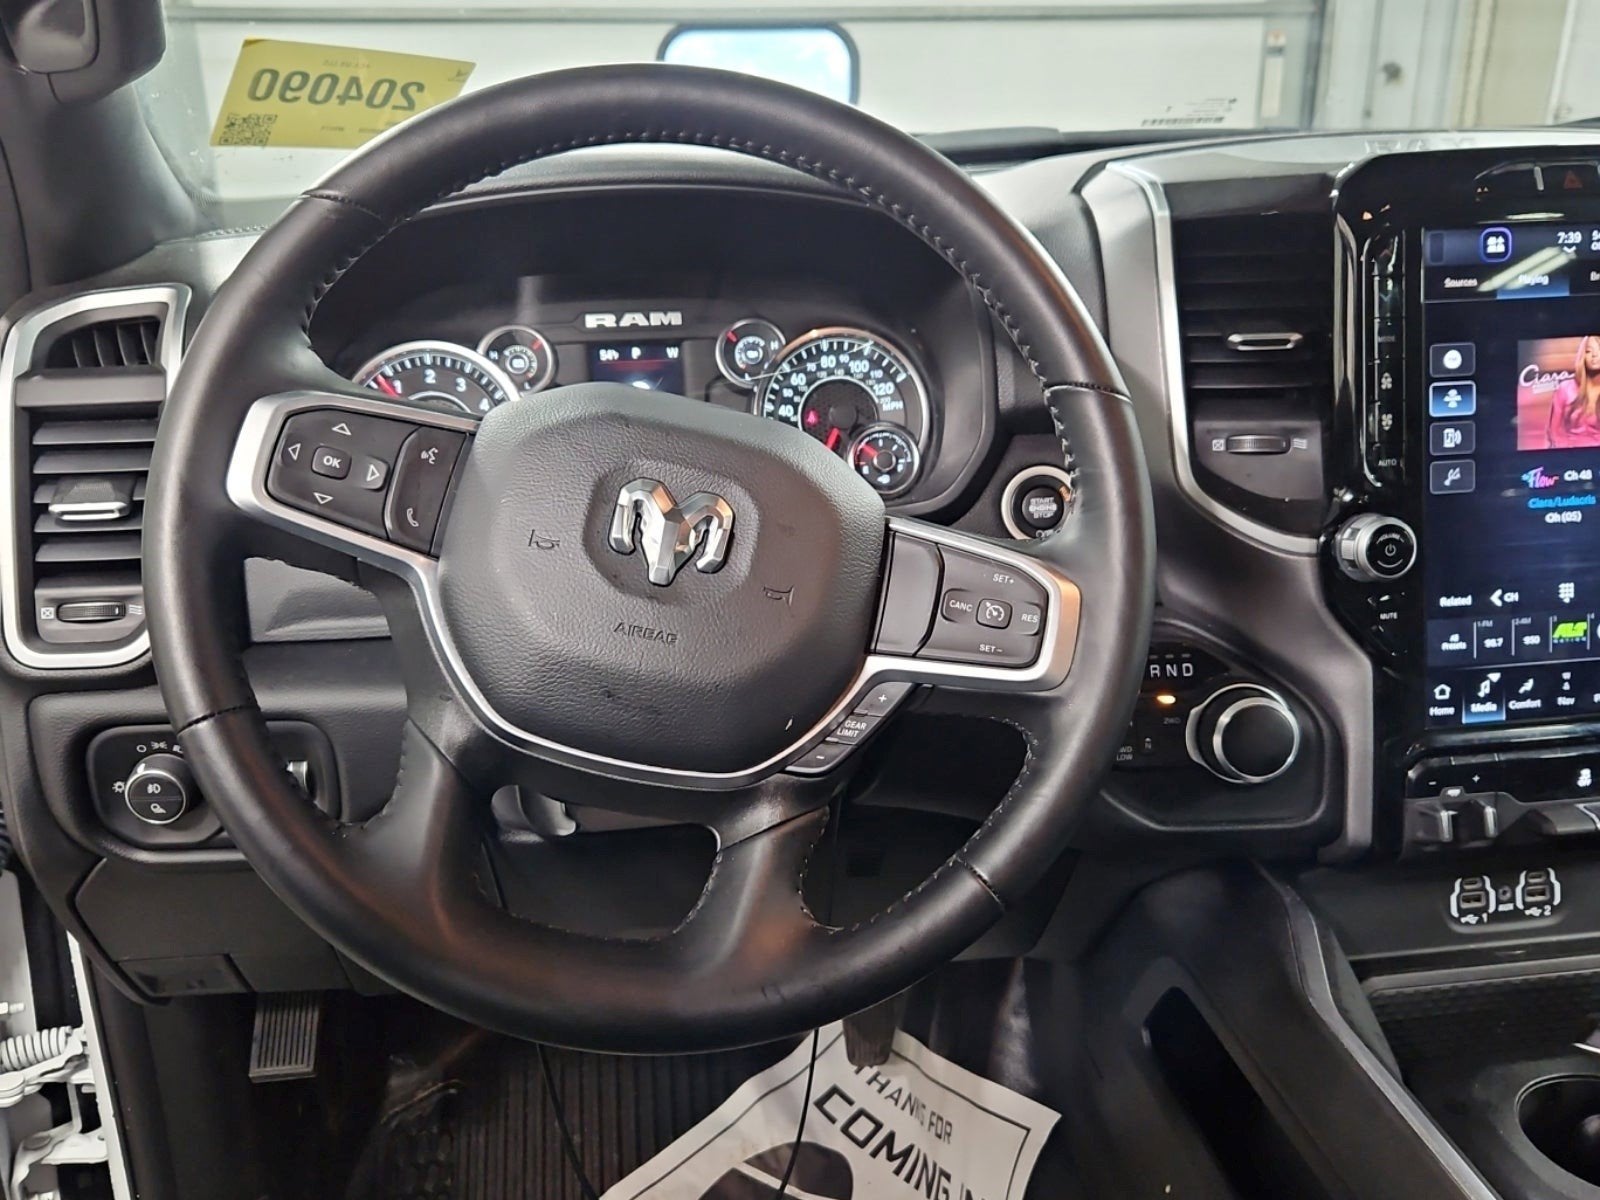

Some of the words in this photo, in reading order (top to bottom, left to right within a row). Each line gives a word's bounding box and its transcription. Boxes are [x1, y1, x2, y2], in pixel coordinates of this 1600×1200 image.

[1557, 231, 1582, 244] 7:39
[1444, 277, 1478, 288] Sources
[584, 311, 683, 329] RAM
[631, 346, 642, 360] P
[666, 346, 679, 359] W
[820, 355, 836, 369] 80
[849, 359, 869, 373] 100
[424, 369, 437, 384] 2
[790, 372, 807, 387] 60
[1519, 364, 1576, 387] Ciara
[455, 377, 467, 392] 3
[873, 382, 895, 396] 120
[479, 398, 491, 412] 4
[778, 404, 794, 418] 40
[882, 400, 904, 411] MPH
[323, 455, 341, 469] OK
[1378, 457, 1397, 467] AUTO
[1528, 466, 1560, 489] Flow
[948, 599, 974, 612] CANC
[1021, 612, 1039, 624] RES
[1379, 611, 1398, 620] MUTE
[613, 622, 678, 644] AIRBAG
[1150, 664, 1161, 679] R
[1166, 663, 1178, 677] N
[1182, 662, 1194, 677] D
[1429, 705, 1455, 717] Home
[1470, 702, 1498, 713] Media
[844, 719, 868, 730] GEAR
[836, 728, 859, 738] LIMIT
[1116, 753, 1134, 761] LOW
[1543, 904, 1552, 916] 2
[1481, 912, 1489, 924] 1
[927, 1110, 953, 1145] FOR
[813, 1084, 953, 1200] COMING
